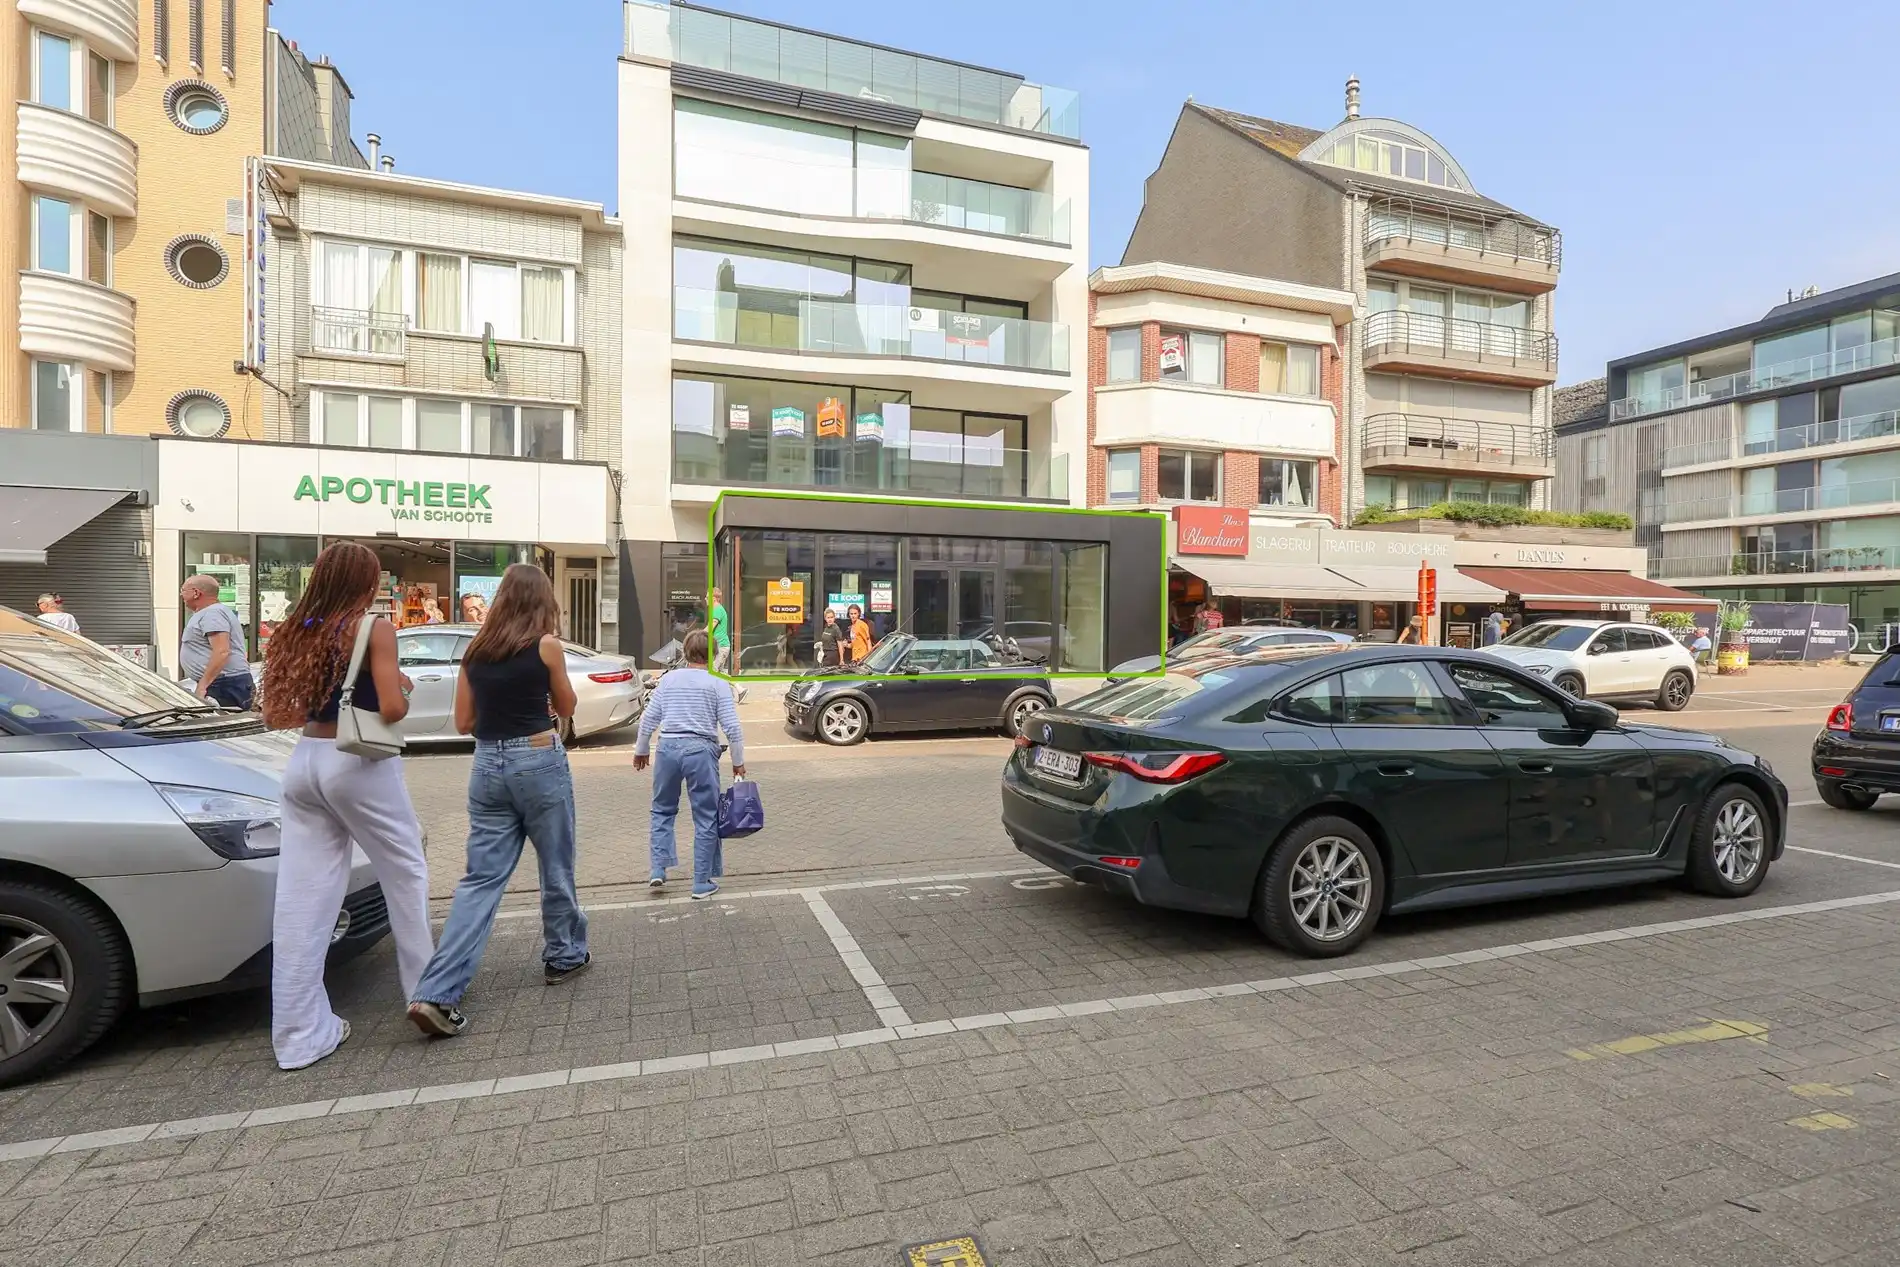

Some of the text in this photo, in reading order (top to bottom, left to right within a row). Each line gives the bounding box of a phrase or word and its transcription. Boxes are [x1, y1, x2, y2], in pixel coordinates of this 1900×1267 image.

[294, 475, 492, 509] APOTHEEK
[390, 508, 492, 524] VAN SCHOOTE
[1256, 536, 1449, 556] SLAGERIJ TRAITEUR BOUCHERIE
[1517, 549, 1566, 564] DANTES
[463, 580, 498, 591] CAUD
[841, 594, 863, 602] KOOP
[1742, 629, 1805, 637] OPARCHITECTUUR
